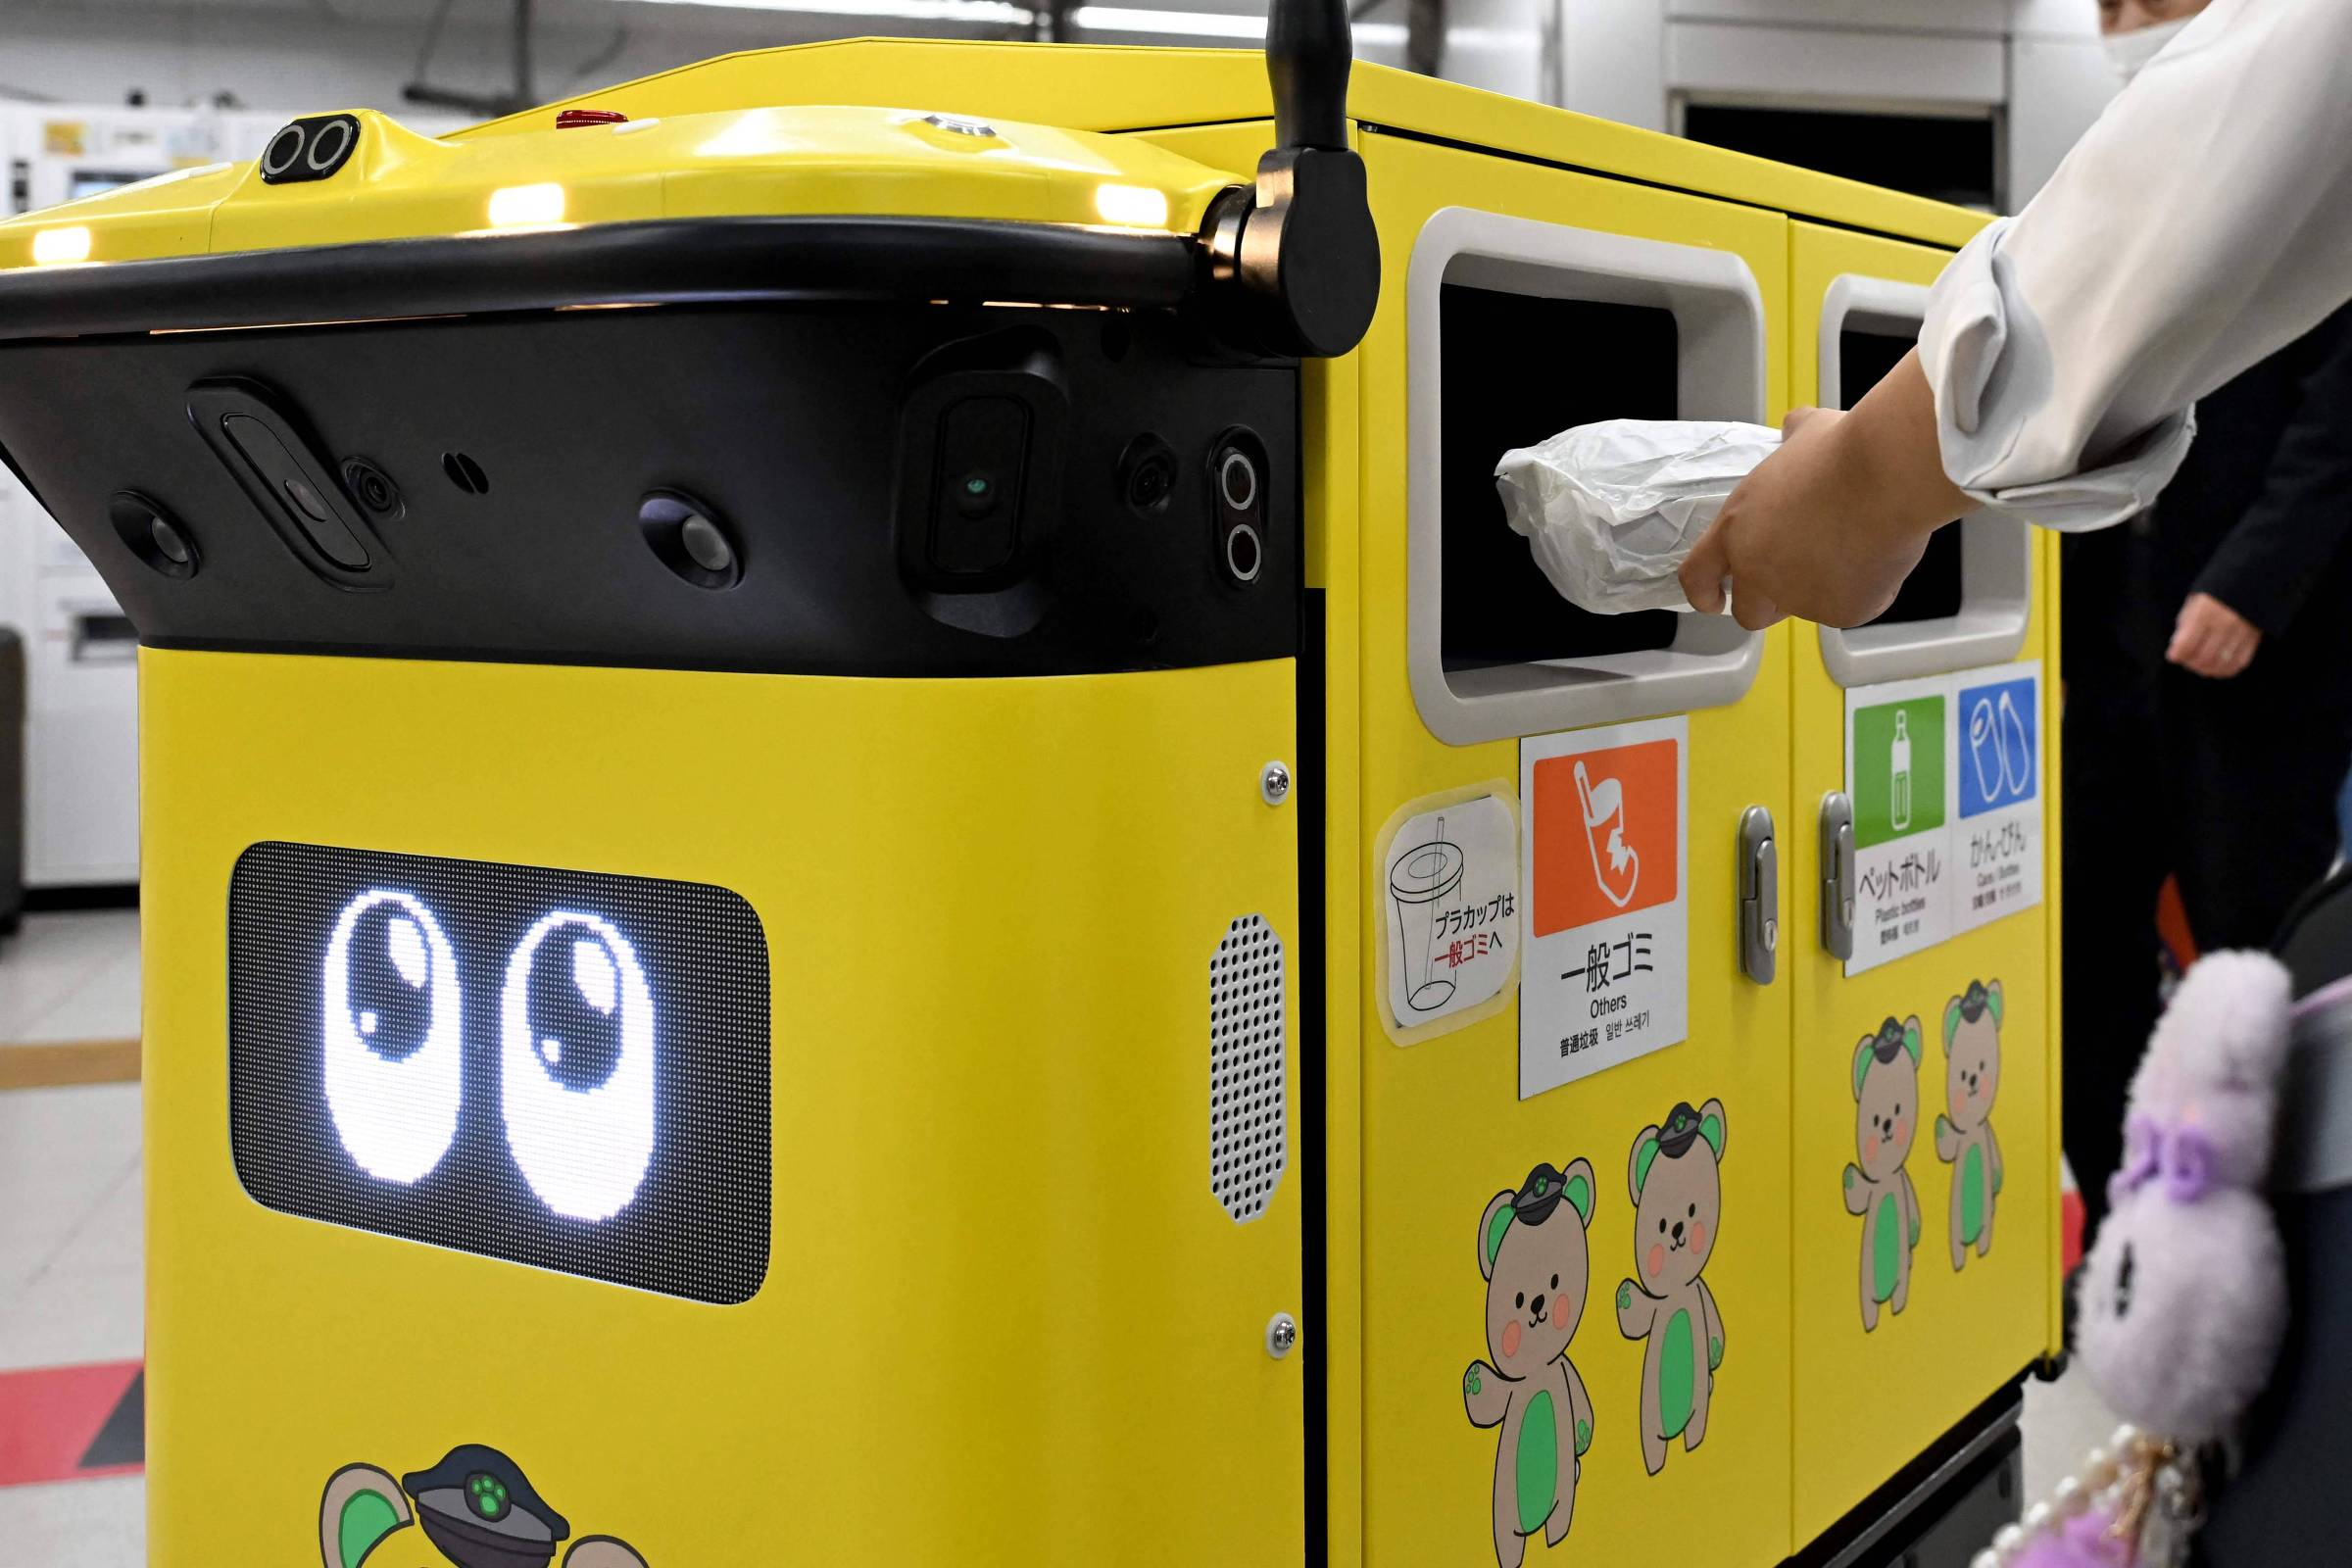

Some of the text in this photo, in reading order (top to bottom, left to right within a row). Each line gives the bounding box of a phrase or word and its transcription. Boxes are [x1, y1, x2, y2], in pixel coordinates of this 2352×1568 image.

[1859, 848, 1941, 901] ペットボトル
[1435, 892, 1515, 939] プラカップは
[1435, 931, 1502, 968] 一般ゴミへ
[1560, 932, 1653, 993] 一般ゴミ
[1590, 995, 1627, 1018] Others
[1560, 1028, 1598, 1058] 普通垃圾
[1605, 1009, 1649, 1042] 일반 쓰레기
